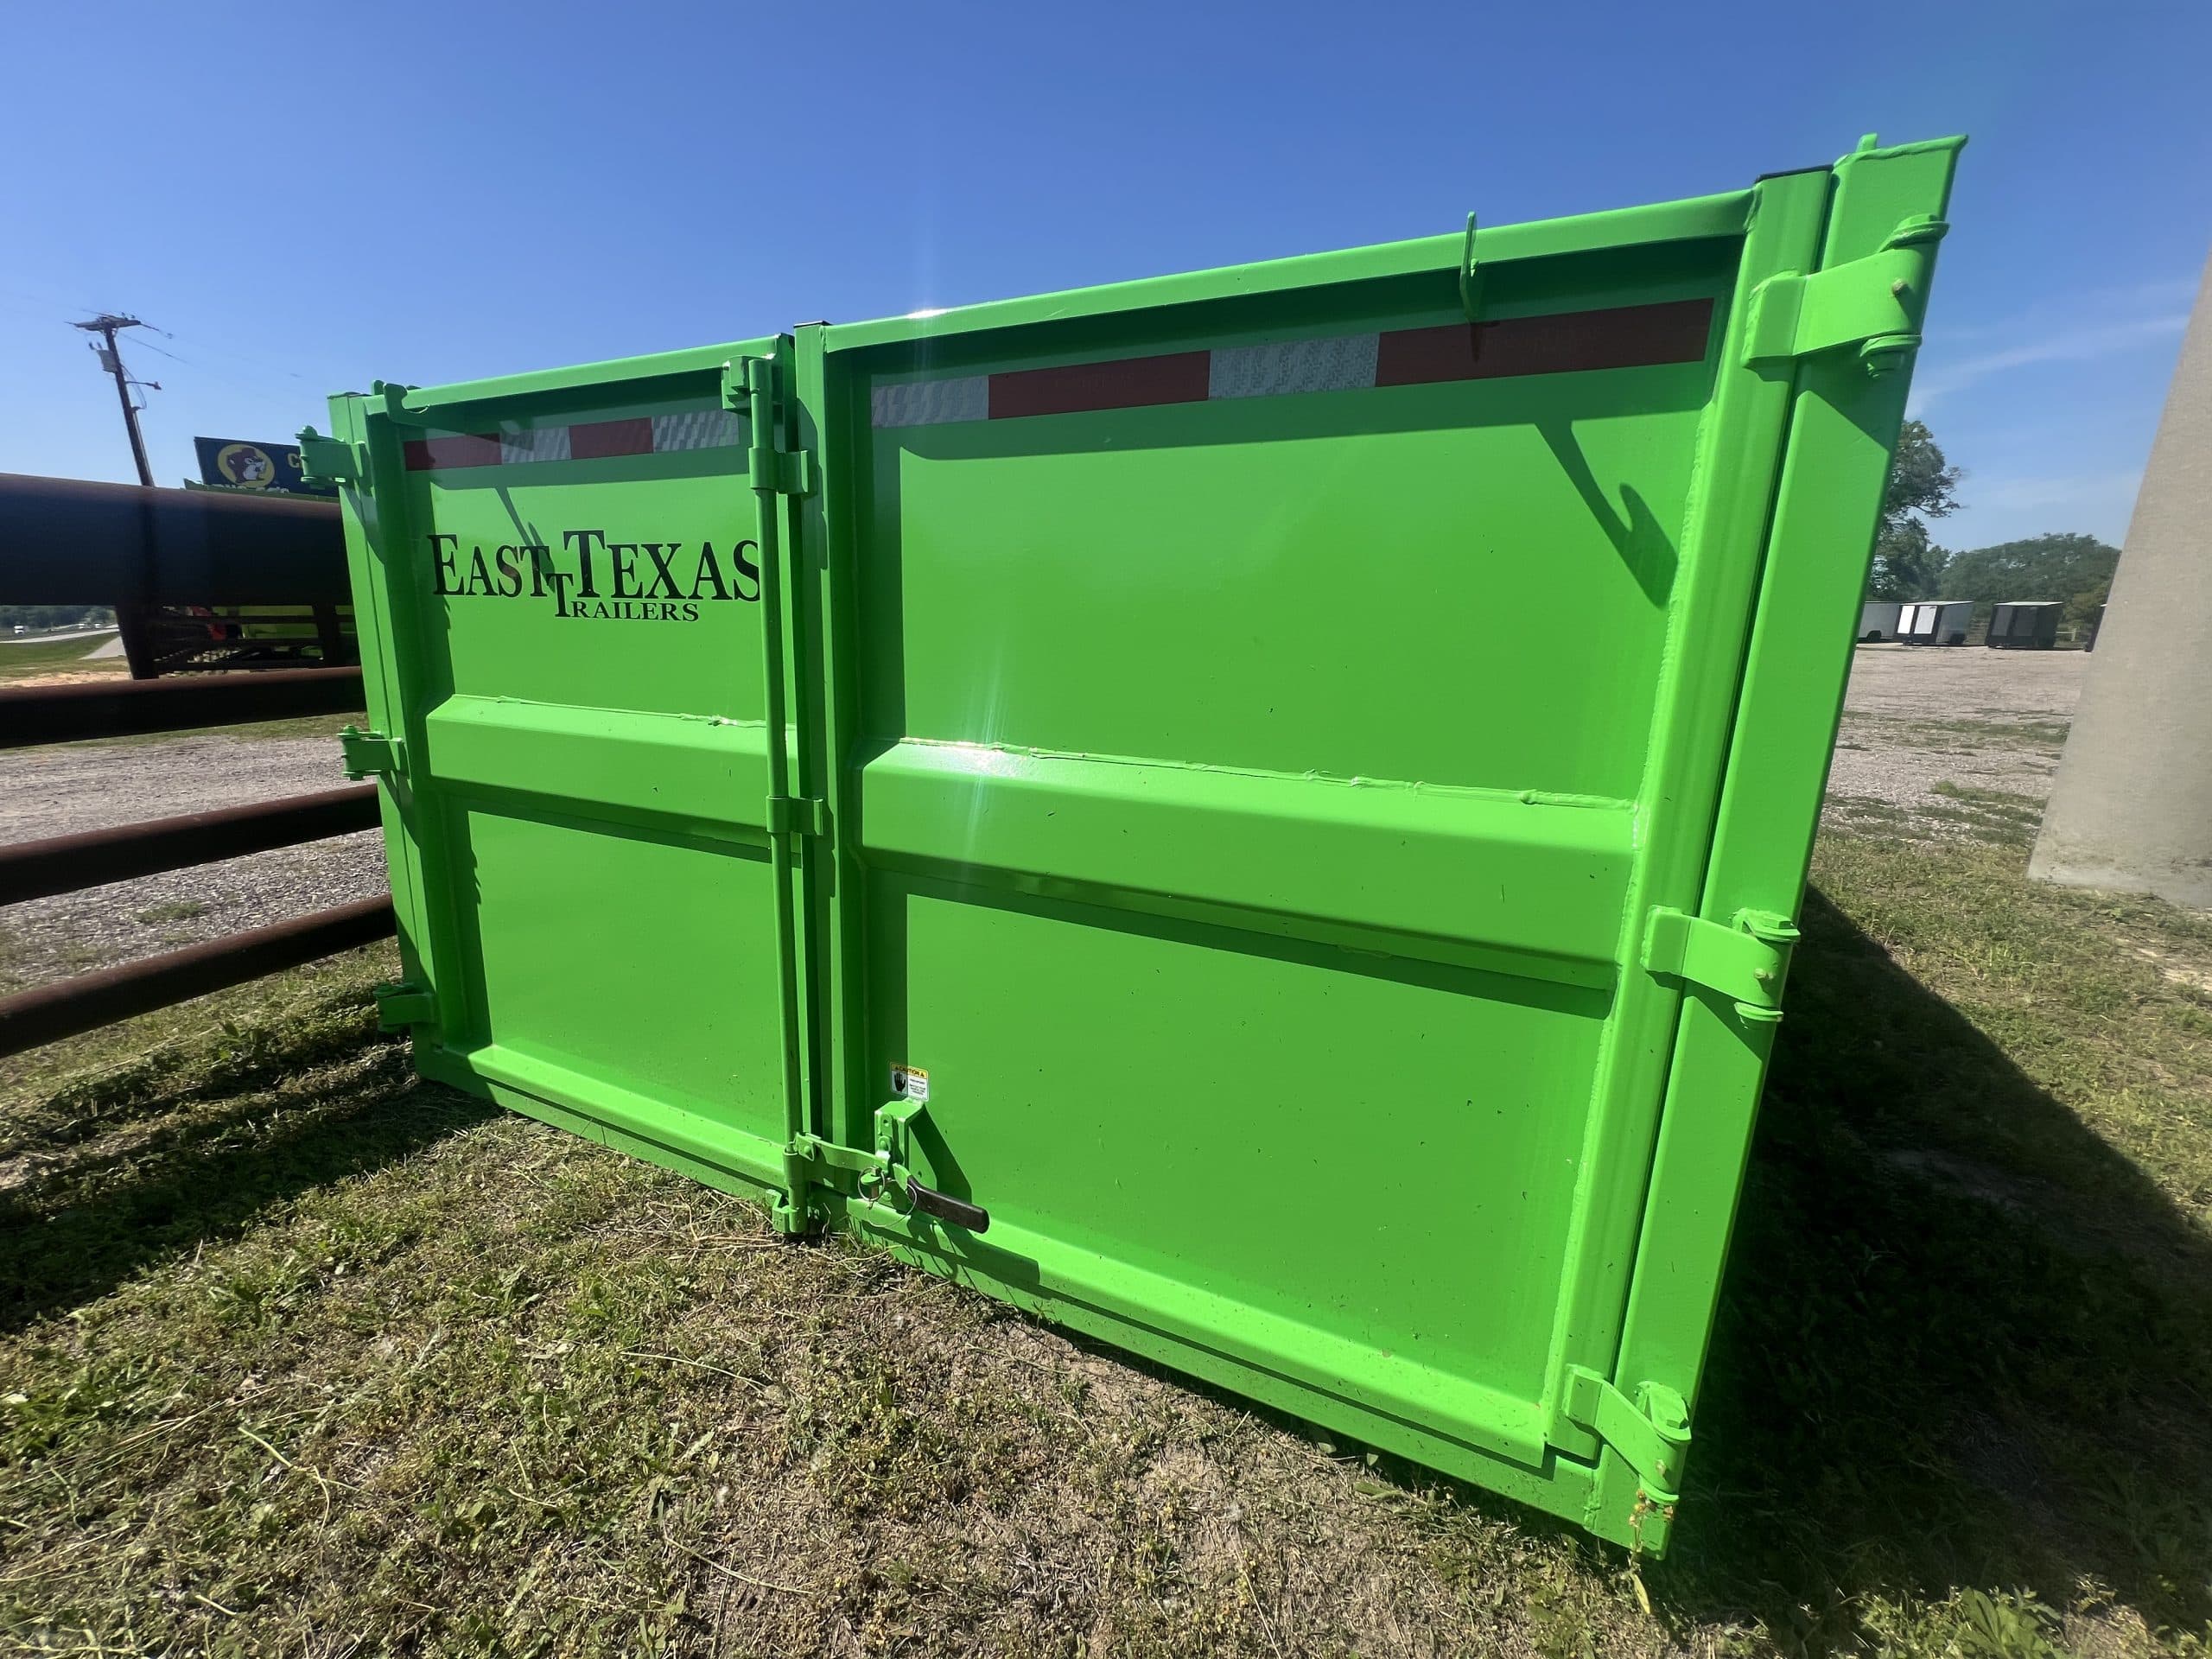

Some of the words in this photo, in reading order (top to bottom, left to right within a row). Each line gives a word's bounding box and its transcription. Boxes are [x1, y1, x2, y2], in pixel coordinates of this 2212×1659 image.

[428, 534, 550, 598] EAST
[563, 530, 760, 602] TEXAS
[546, 573, 699, 621] TRAILERS
